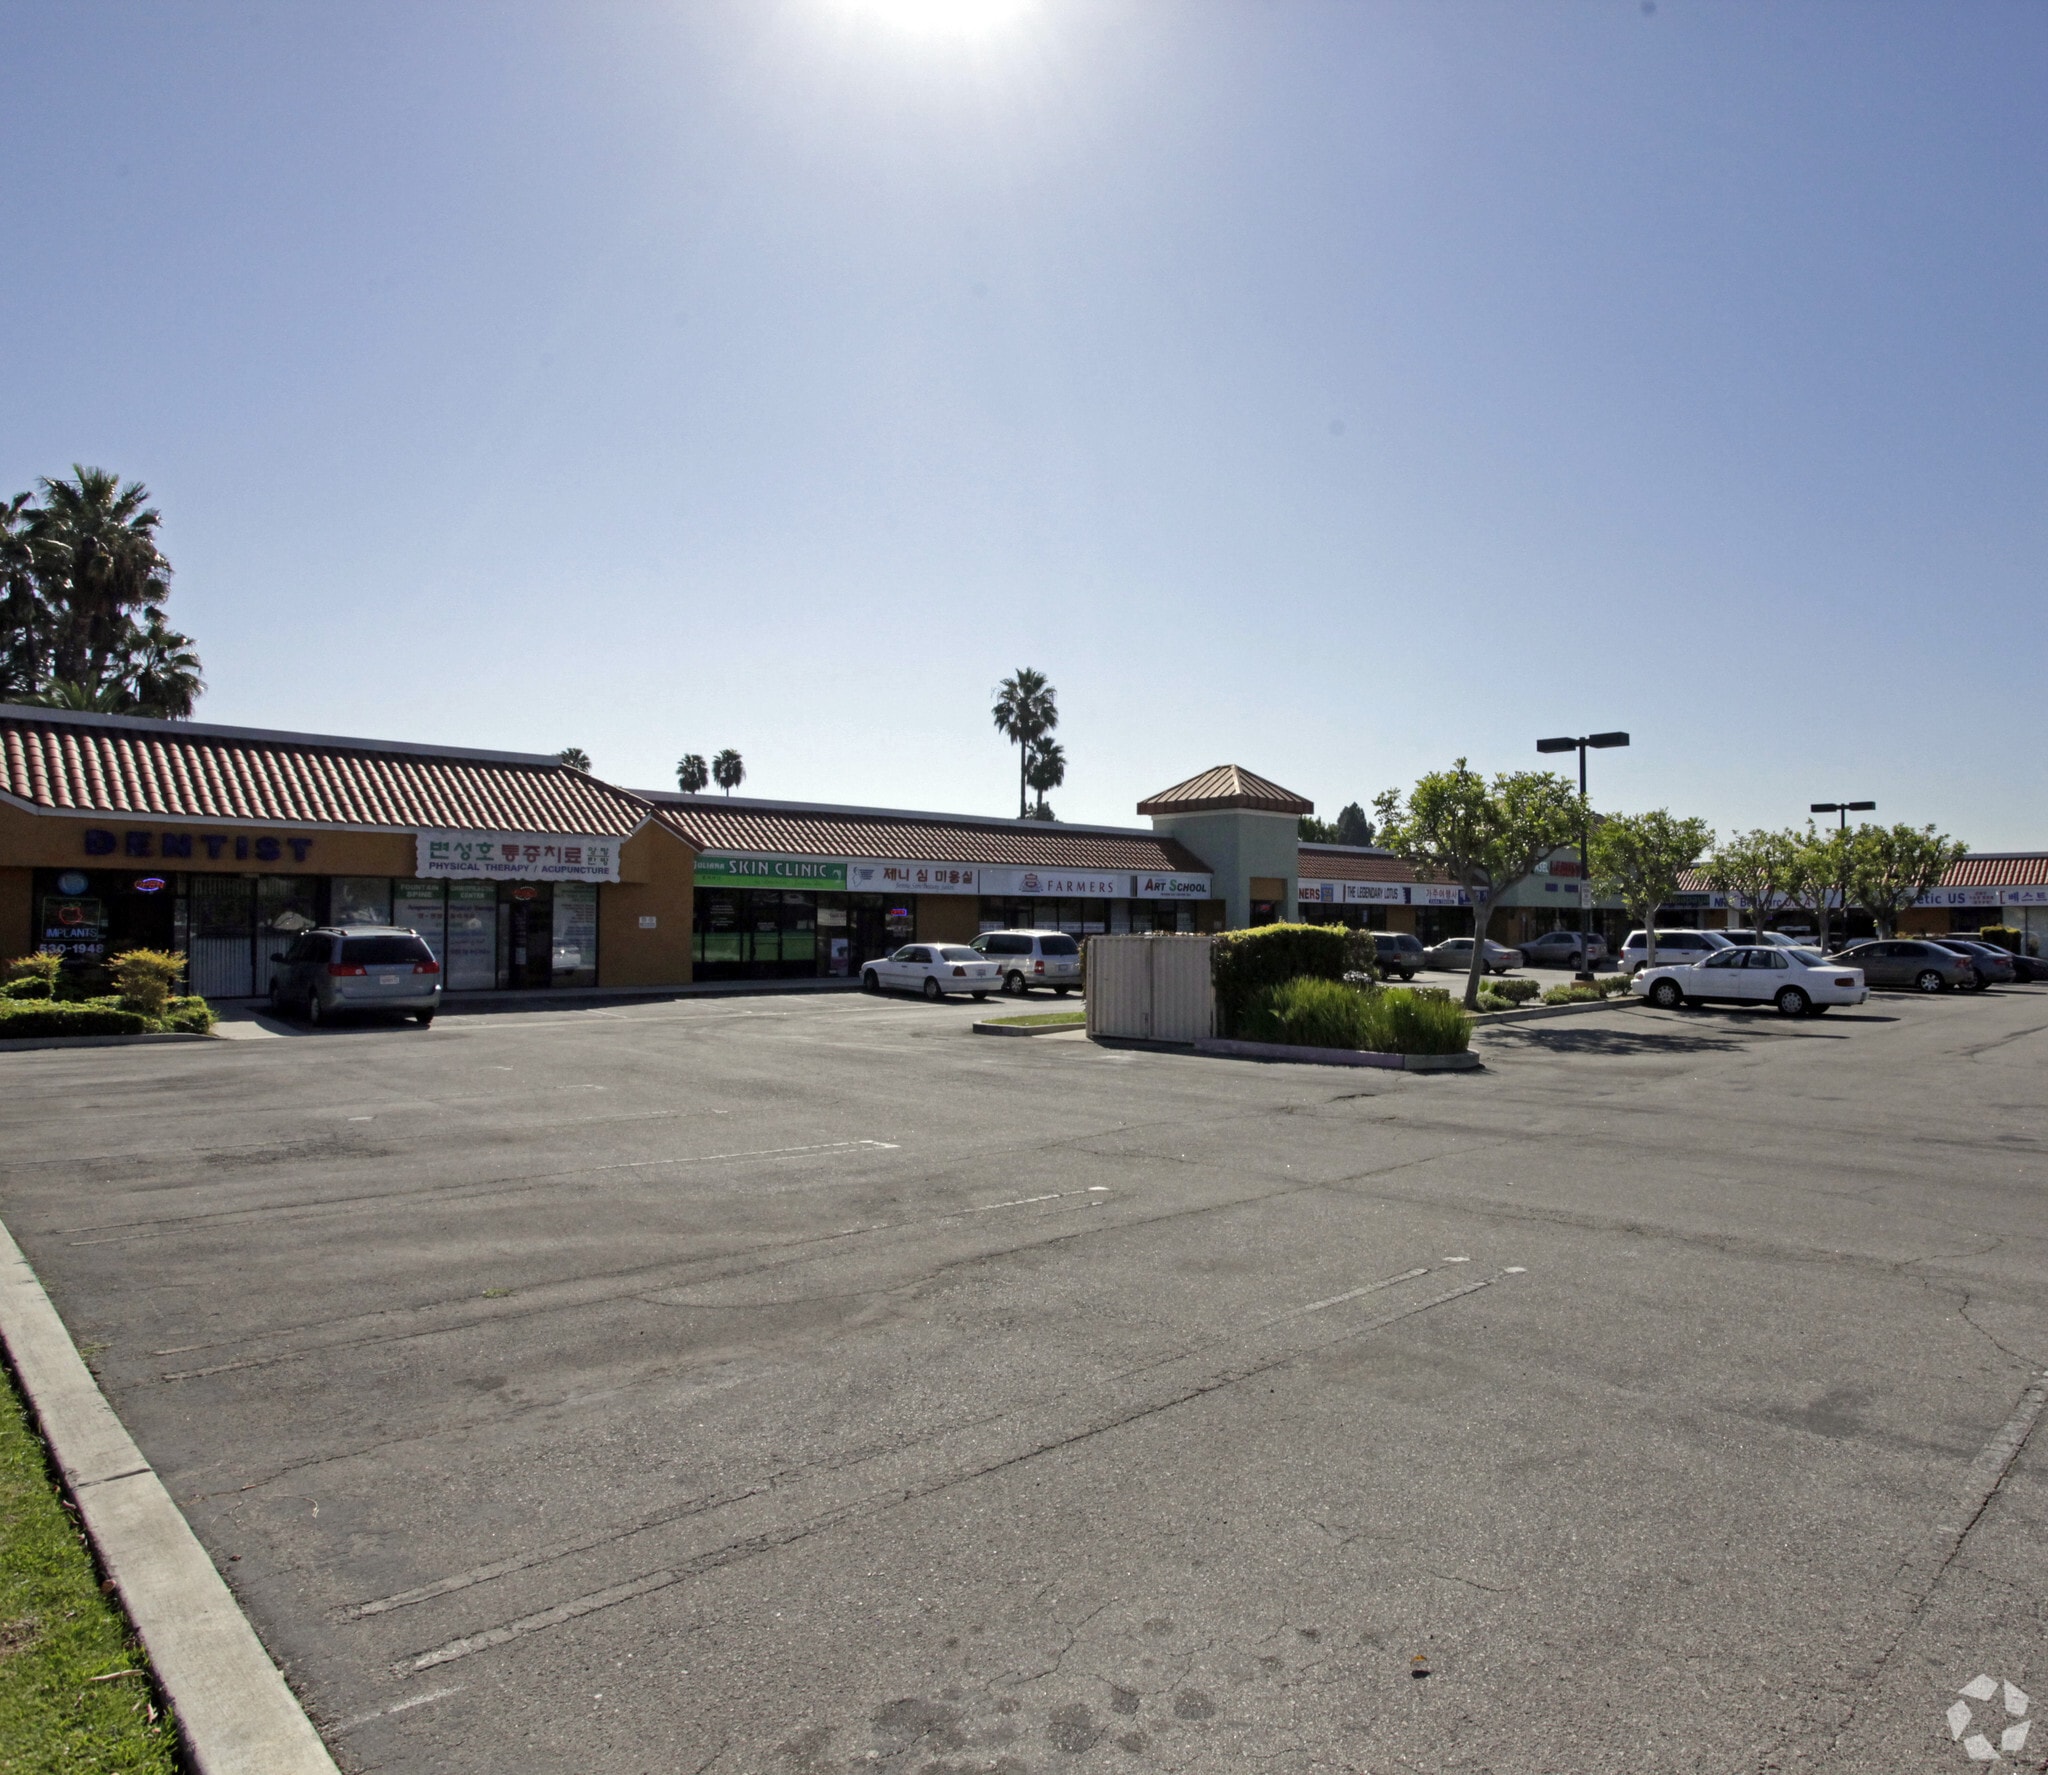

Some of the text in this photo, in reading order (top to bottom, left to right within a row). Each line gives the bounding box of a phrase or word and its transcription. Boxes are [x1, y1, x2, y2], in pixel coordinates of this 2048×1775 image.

[84, 829, 313, 862] DENTIST
[501, 844, 582, 864] 통증치료
[429, 862, 480, 871] PHYSICAL
[486, 863, 529, 872] THERAPY
[541, 865, 610, 875] ACUPUNCTURE
[729, 860, 769, 875] SKIN
[775, 863, 827, 877] CLINIC
[935, 870, 973, 884] 미용실
[1047, 880, 1113, 892] FARMERS
[1144, 878, 1206, 892] ART SCHOOL
[1347, 886, 1356, 898] THE
[1357, 886, 1383, 899] LEGENDARY
[1384, 887, 1398, 900] LOTUS
[1947, 893, 1966, 904] US
[46, 928, 97, 938] IMPLANTS
